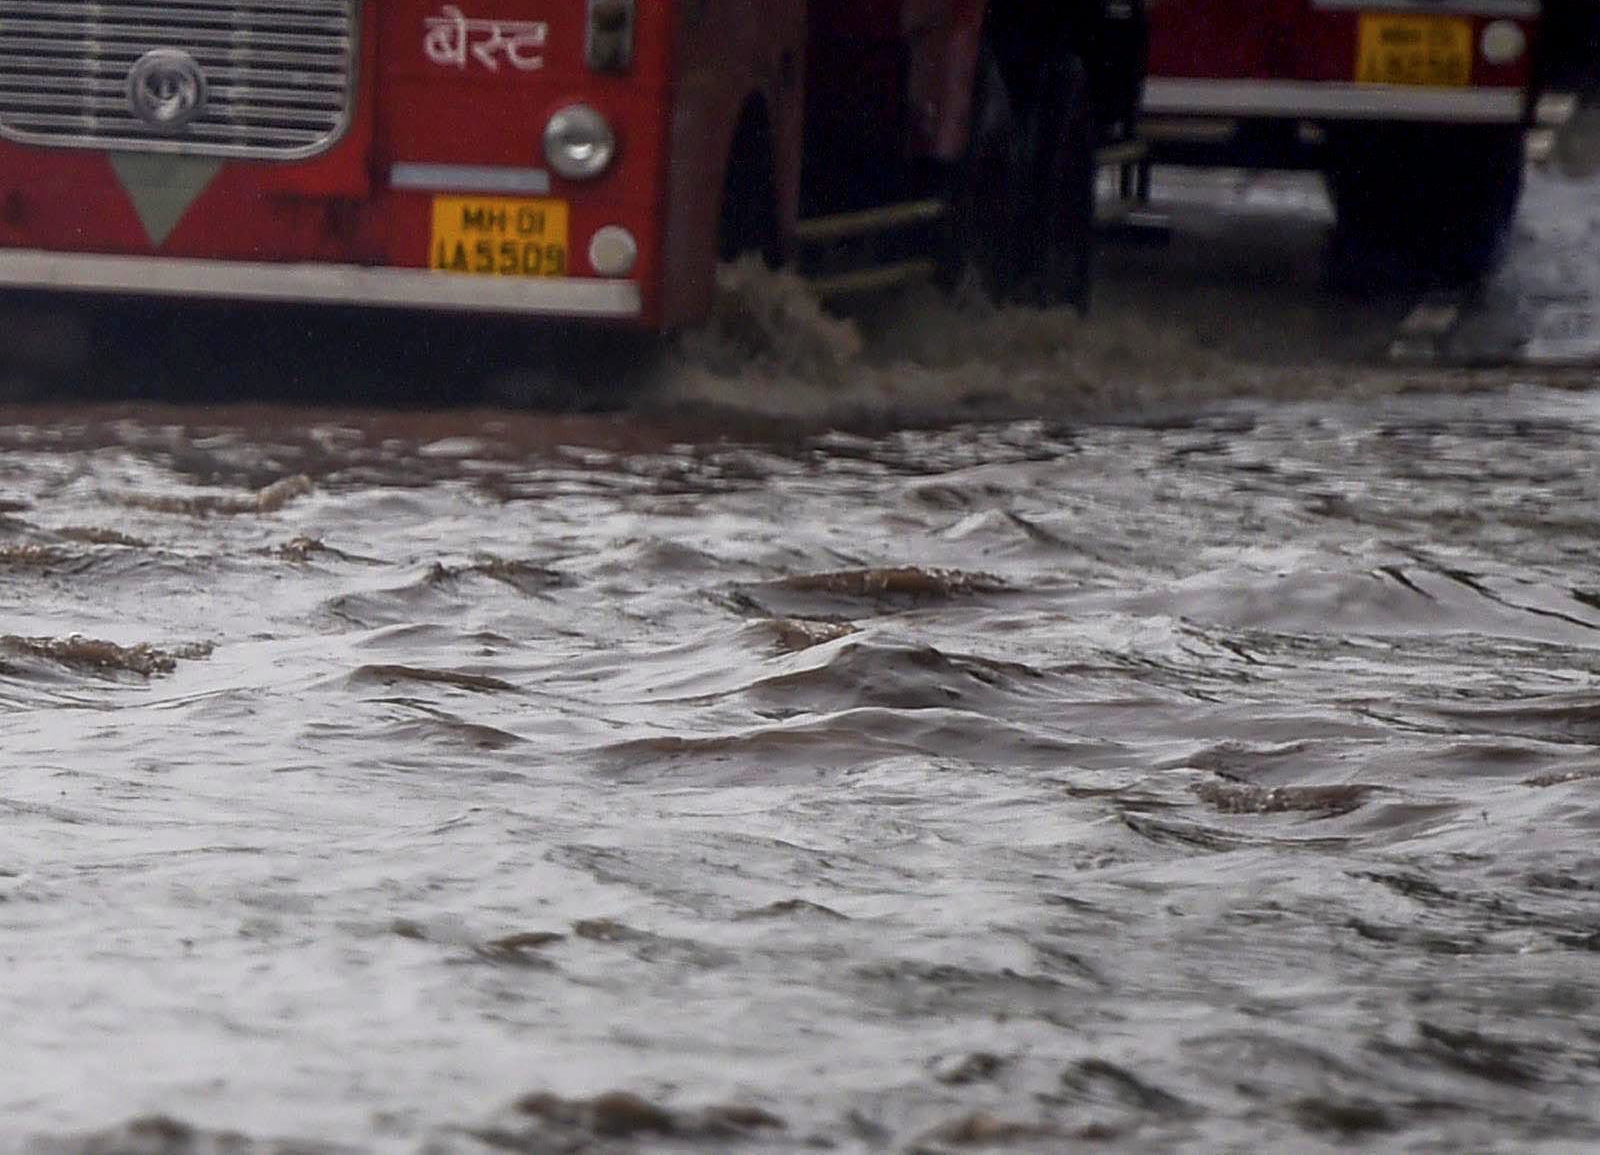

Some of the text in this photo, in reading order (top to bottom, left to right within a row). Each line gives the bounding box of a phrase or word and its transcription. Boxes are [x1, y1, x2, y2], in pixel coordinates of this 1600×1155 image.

[423, 3, 549, 72] बेस्ट
[462, 206, 546, 236] MH 01
[436, 238, 566, 276] LA5509
